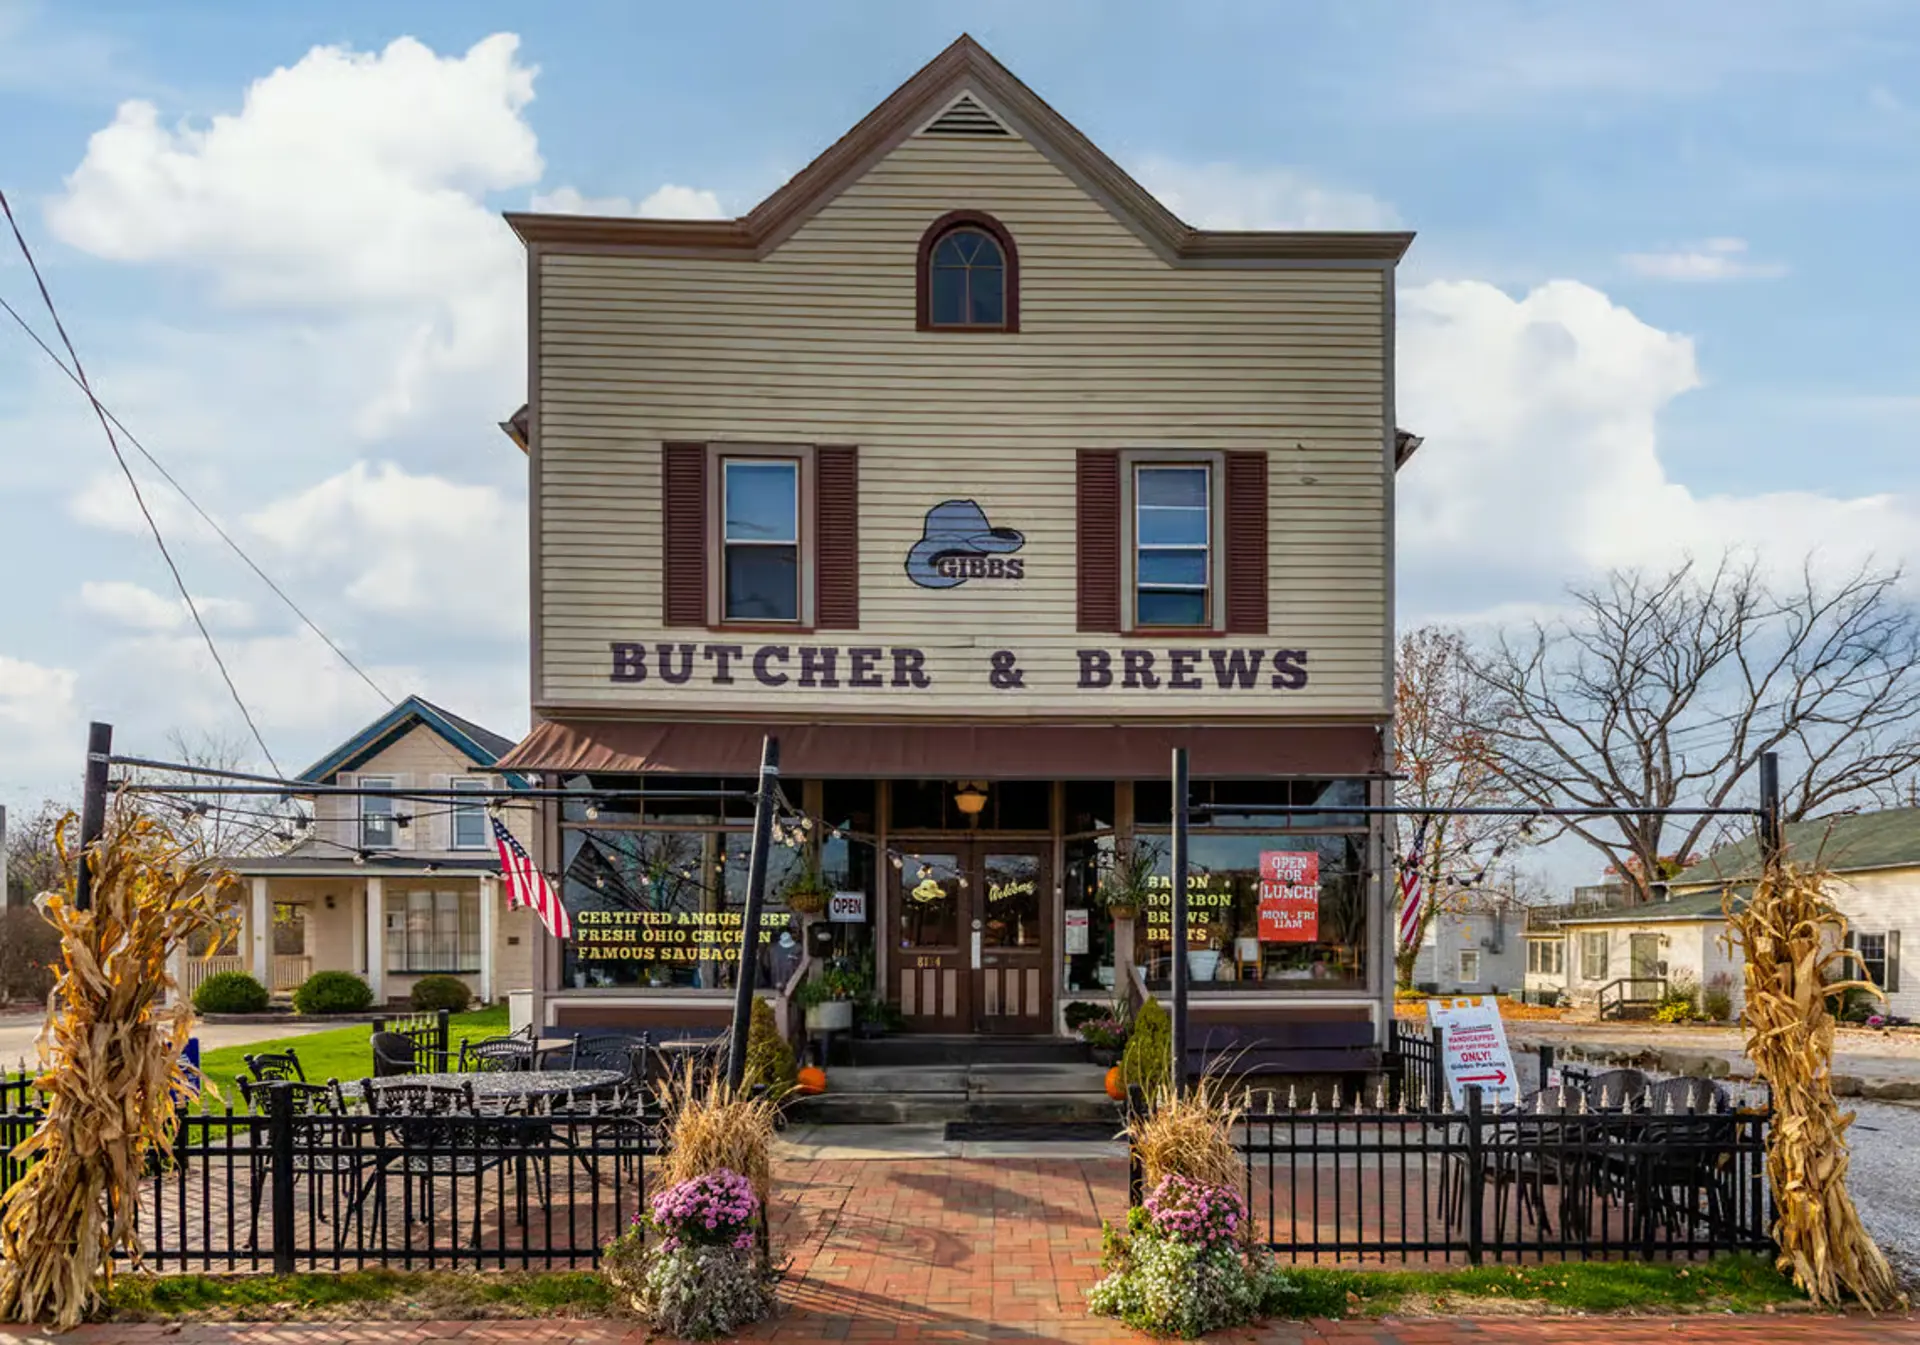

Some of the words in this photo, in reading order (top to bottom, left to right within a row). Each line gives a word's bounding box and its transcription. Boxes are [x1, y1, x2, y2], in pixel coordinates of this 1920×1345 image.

[938, 557, 1024, 579] GIBBS
[610, 643, 931, 688] BUTCHER
[990, 650, 1025, 689] &
[1077, 650, 1308, 689] BREWS
[1272, 856, 1307, 869] OPEN
[1276, 869, 1302, 881] FOR
[1147, 876, 1209, 889] BAON
[834, 898, 862, 914] OPEN
[1147, 893, 1232, 906] BORBON
[577, 911, 672, 925] CERTIFIED
[677, 911, 741, 926] ANGUS
[759, 912, 791, 926] EEF
[1147, 911, 1210, 923] BRWS
[1262, 911, 1288, 920] MON
[1297, 911, 1316, 920] FRI
[577, 930, 637, 942] FRESH
[642, 930, 686, 943] OHIO
[692, 930, 772, 943] CHICKN
[1147, 928, 1207, 941] BRTS
[577, 947, 654, 960] FAMOUS
[660, 948, 743, 961] SAUSAG
[1460, 1051, 1492, 1062] ONLY!
